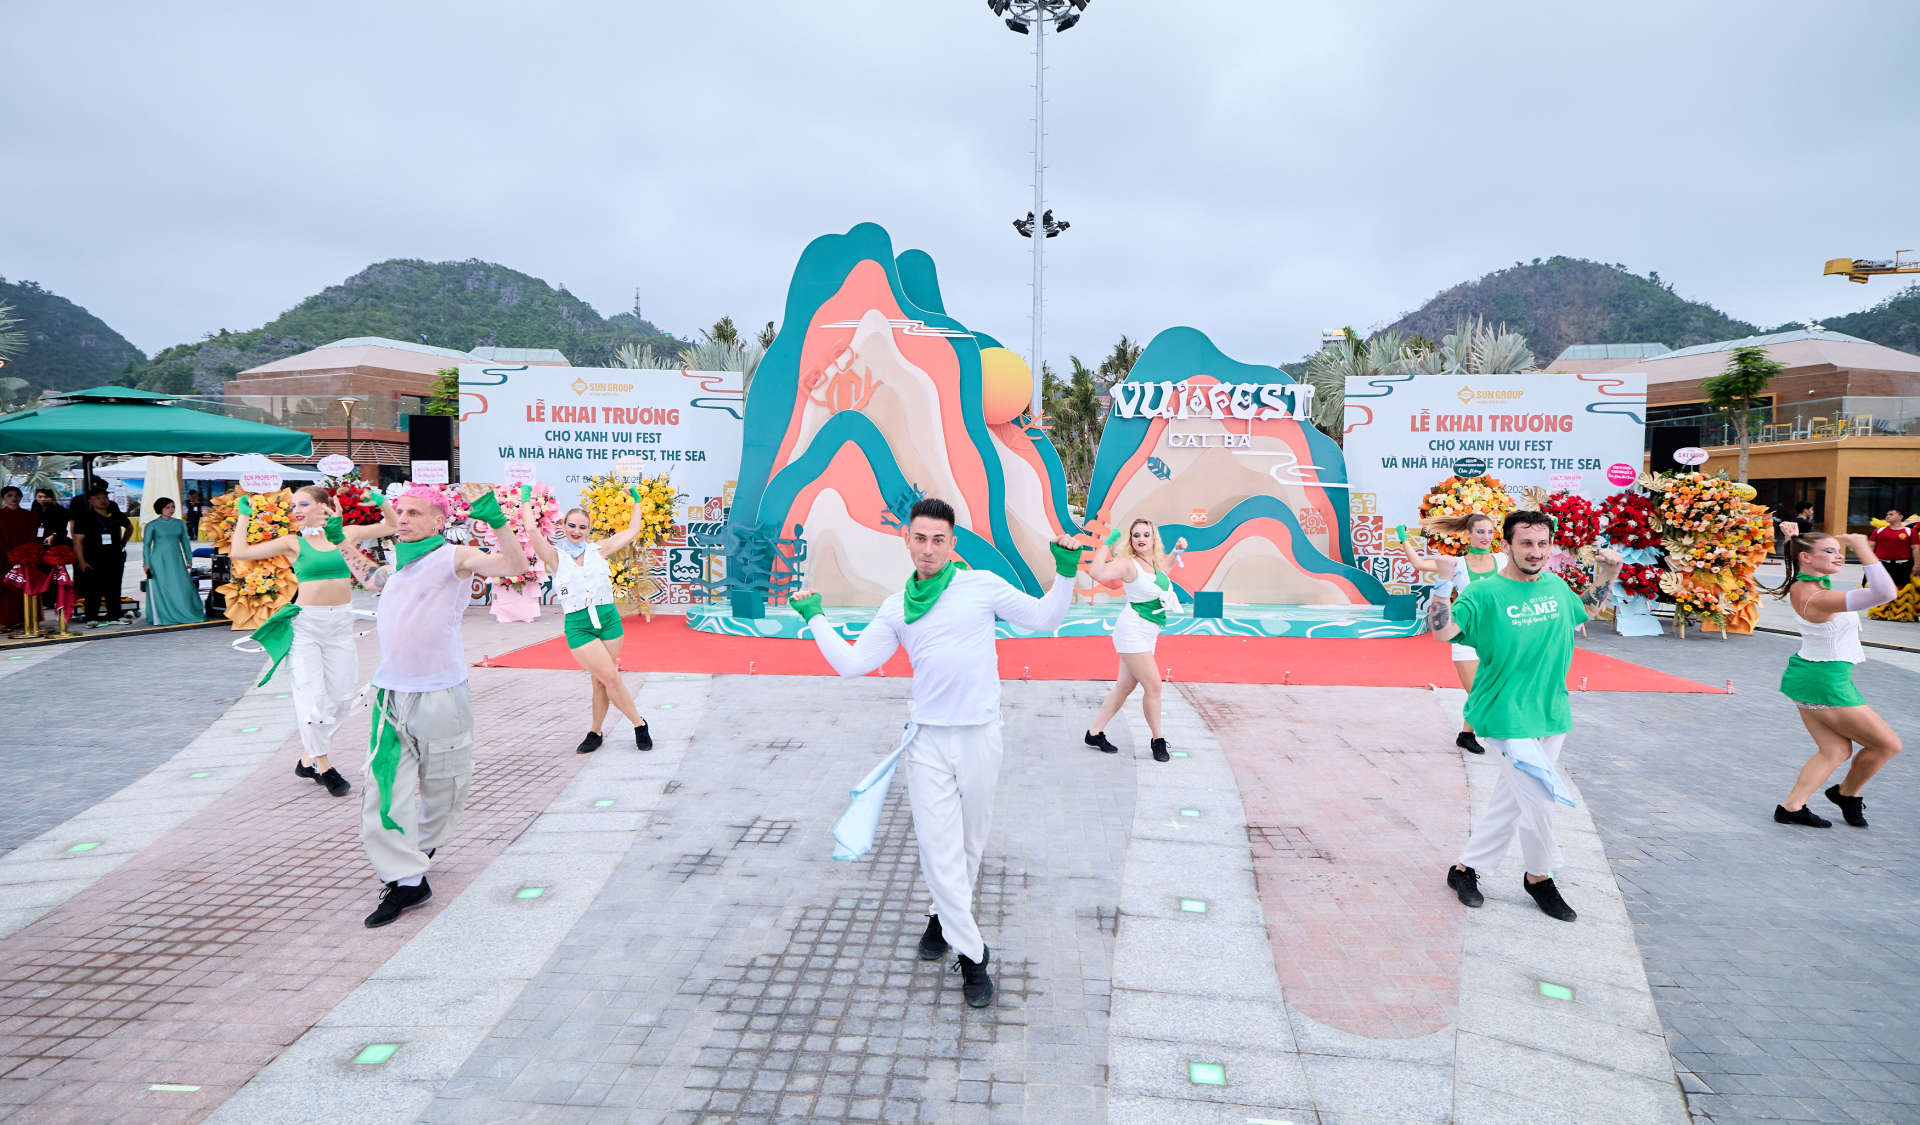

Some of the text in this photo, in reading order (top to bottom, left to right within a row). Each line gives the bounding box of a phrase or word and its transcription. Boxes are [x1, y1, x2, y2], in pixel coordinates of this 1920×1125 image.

[589, 382, 634, 393] SUN GROUP
[1476, 390, 1524, 399] SUN GROUP
[1208, 381, 1315, 421] FEST
[526, 399, 679, 426] LỄ KHAI TRƯƠNG
[1411, 408, 1573, 432] LỄ KHAI TRƯƠNG
[545, 429, 662, 444] CHỢ XANH VUI FEST
[1169, 434, 1249, 447] CAT BA
[498, 445, 515, 458] VÀ
[519, 445, 545, 459] NHÀ
[548, 446, 583, 460] HÀNG
[586, 448, 608, 460] THE
[660, 449, 681, 461] THE
[685, 450, 706, 461] SEA
[1429, 439, 1553, 452] CHỢ XANH VUI FEST
[1382, 455, 1398, 469] VÀ
[1402, 455, 1427, 469] NHÀ
[1432, 455, 1456, 469] HÀN
[1498, 458, 1546, 471] FOREST,
[1550, 458, 1574, 469] THE
[1577, 458, 1601, 470] SEA
